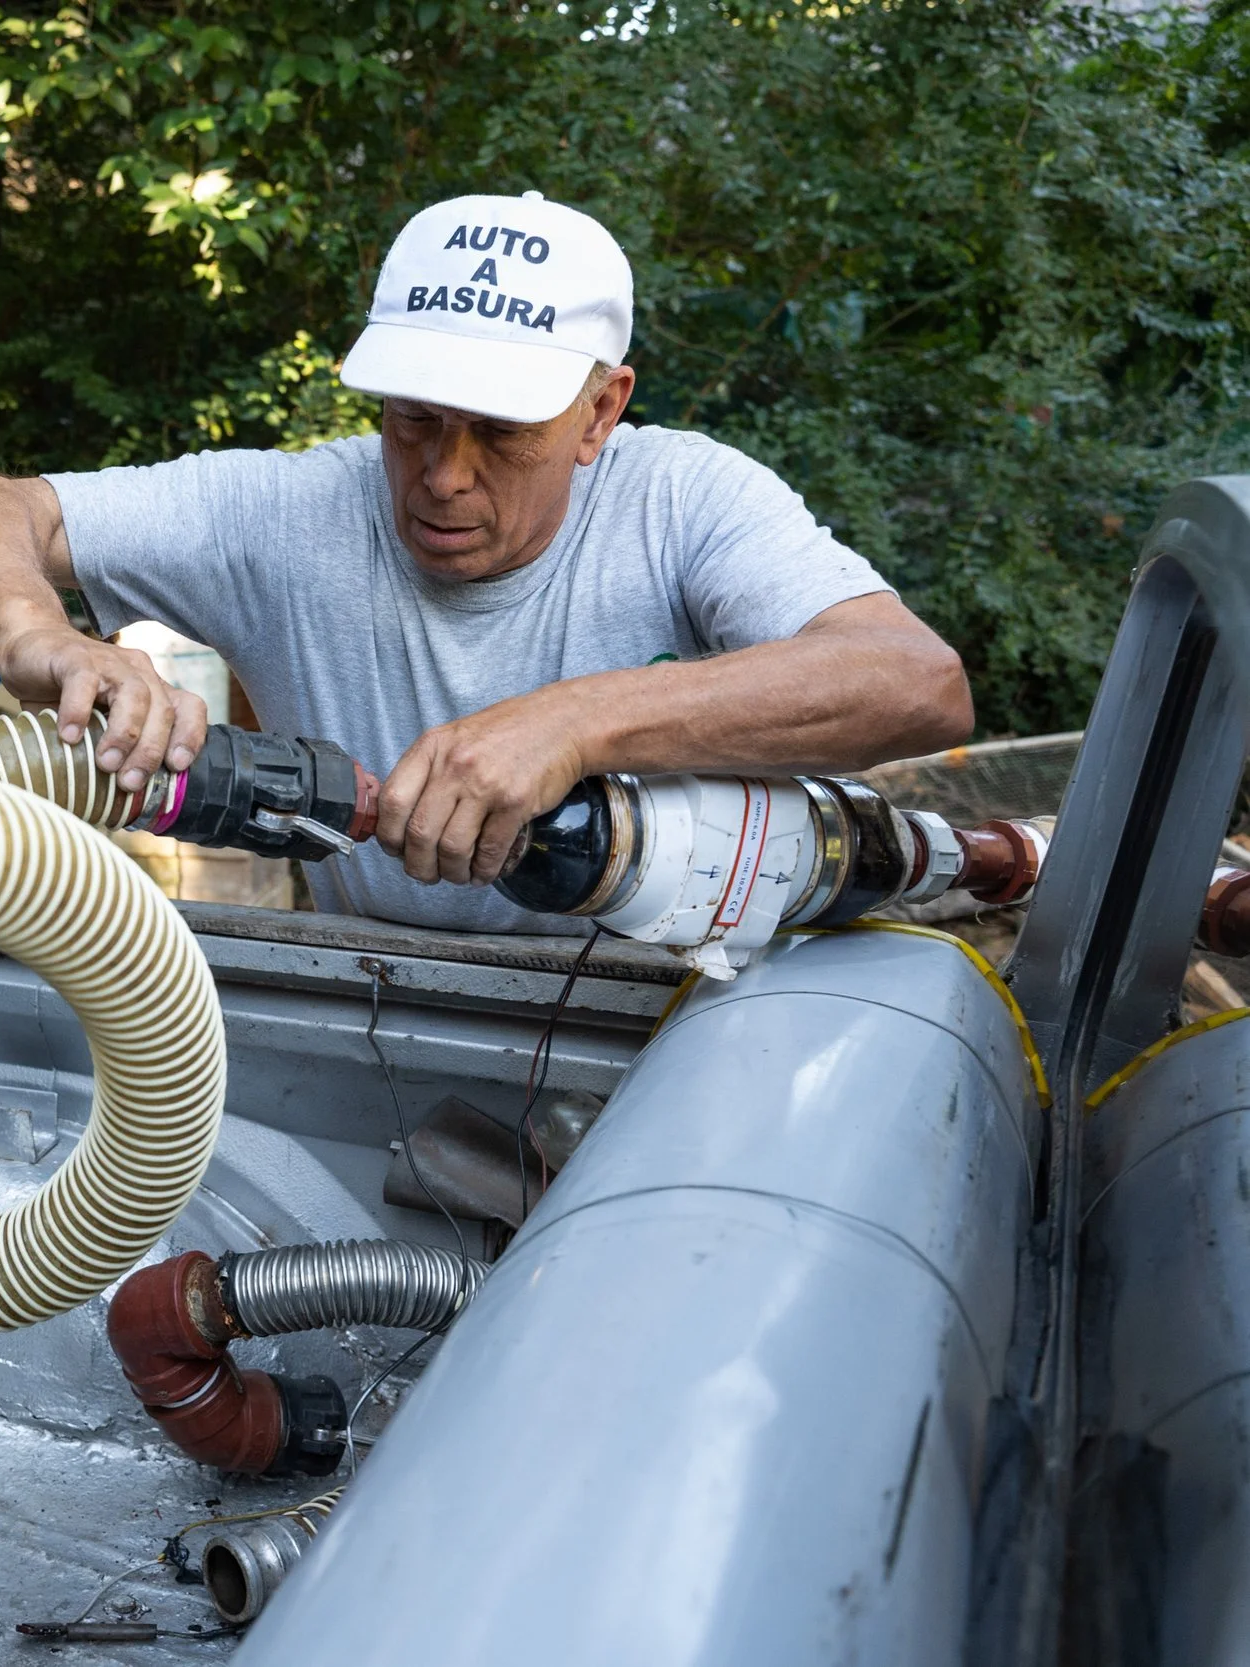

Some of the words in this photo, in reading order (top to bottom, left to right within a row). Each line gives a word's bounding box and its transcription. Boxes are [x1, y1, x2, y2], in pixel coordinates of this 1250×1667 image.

[443, 225, 550, 264] AUTO
[470, 258, 498, 286] A
[407, 286, 556, 333] BASURA
